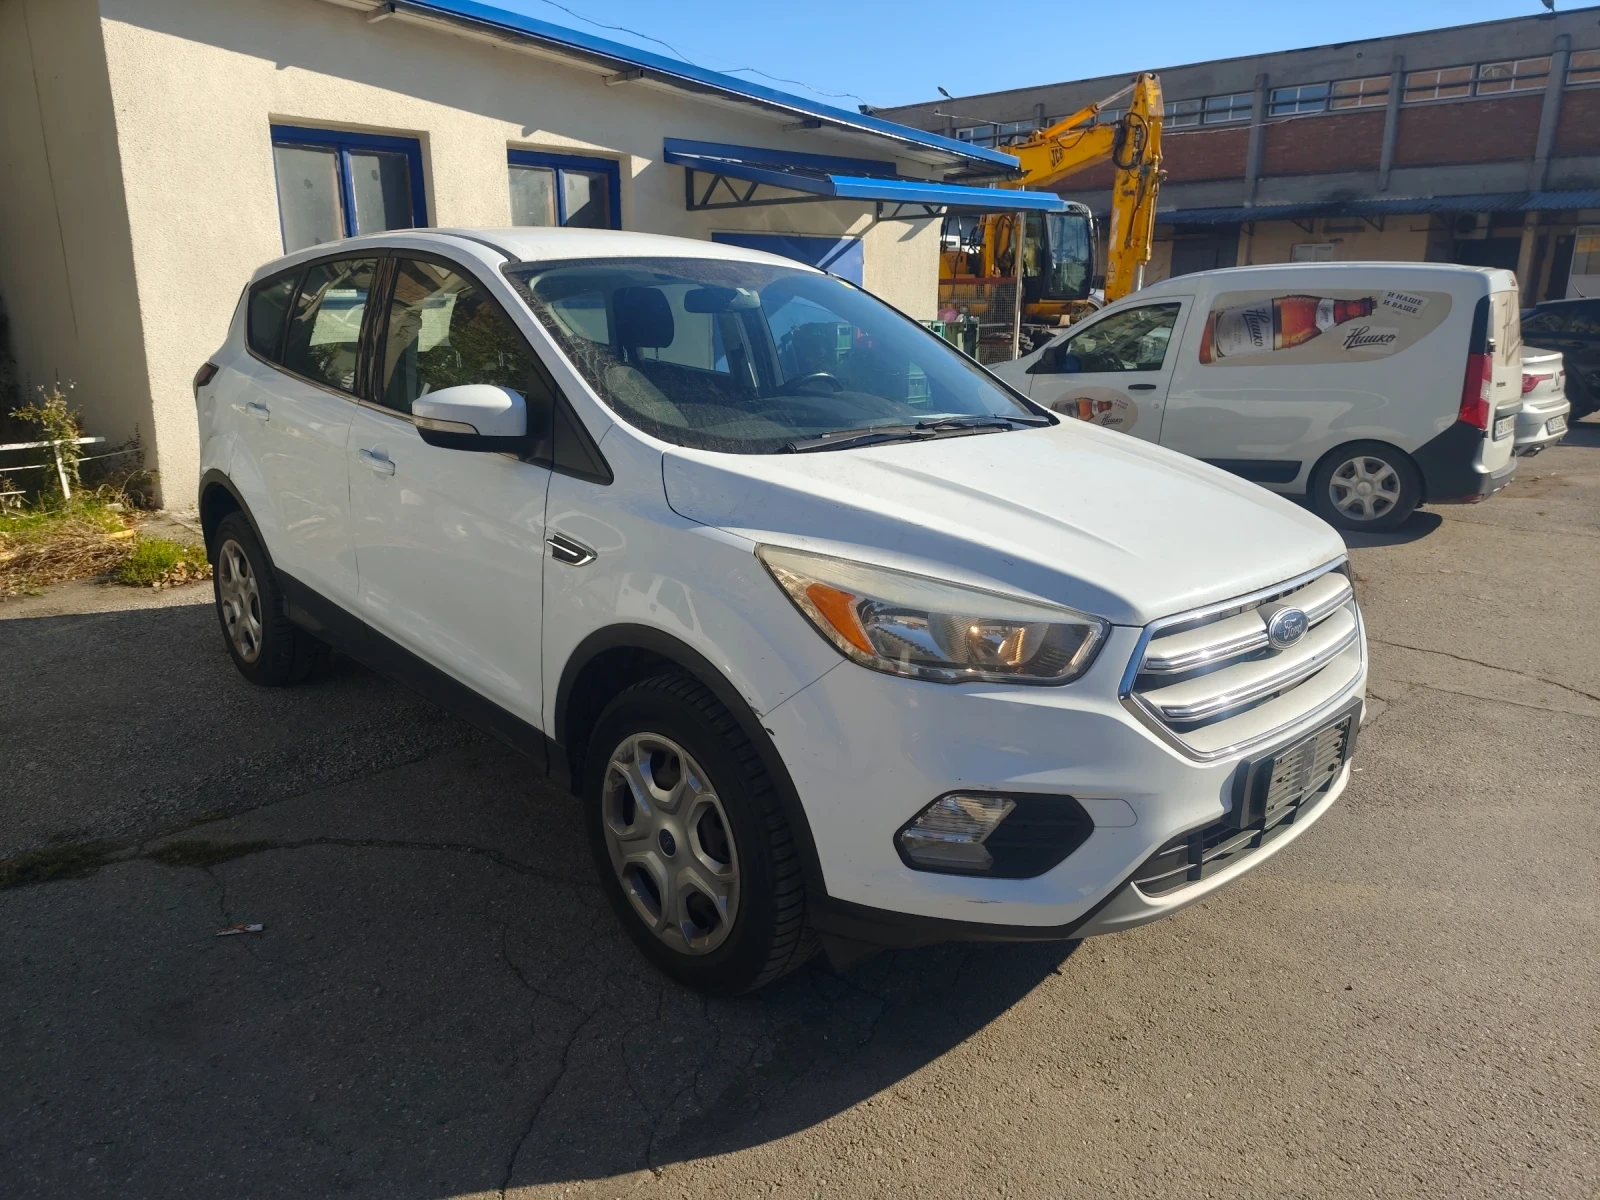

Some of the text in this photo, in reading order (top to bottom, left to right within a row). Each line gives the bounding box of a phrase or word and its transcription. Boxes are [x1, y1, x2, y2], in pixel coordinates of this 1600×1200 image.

[1050, 147, 1063, 168] JCB
[1391, 302, 1418, 314] ВАШЕ
[1395, 294, 1423, 306] НАШЕ
[1342, 325, 1396, 350] Нишко
[1278, 617, 1303, 640] Ford
